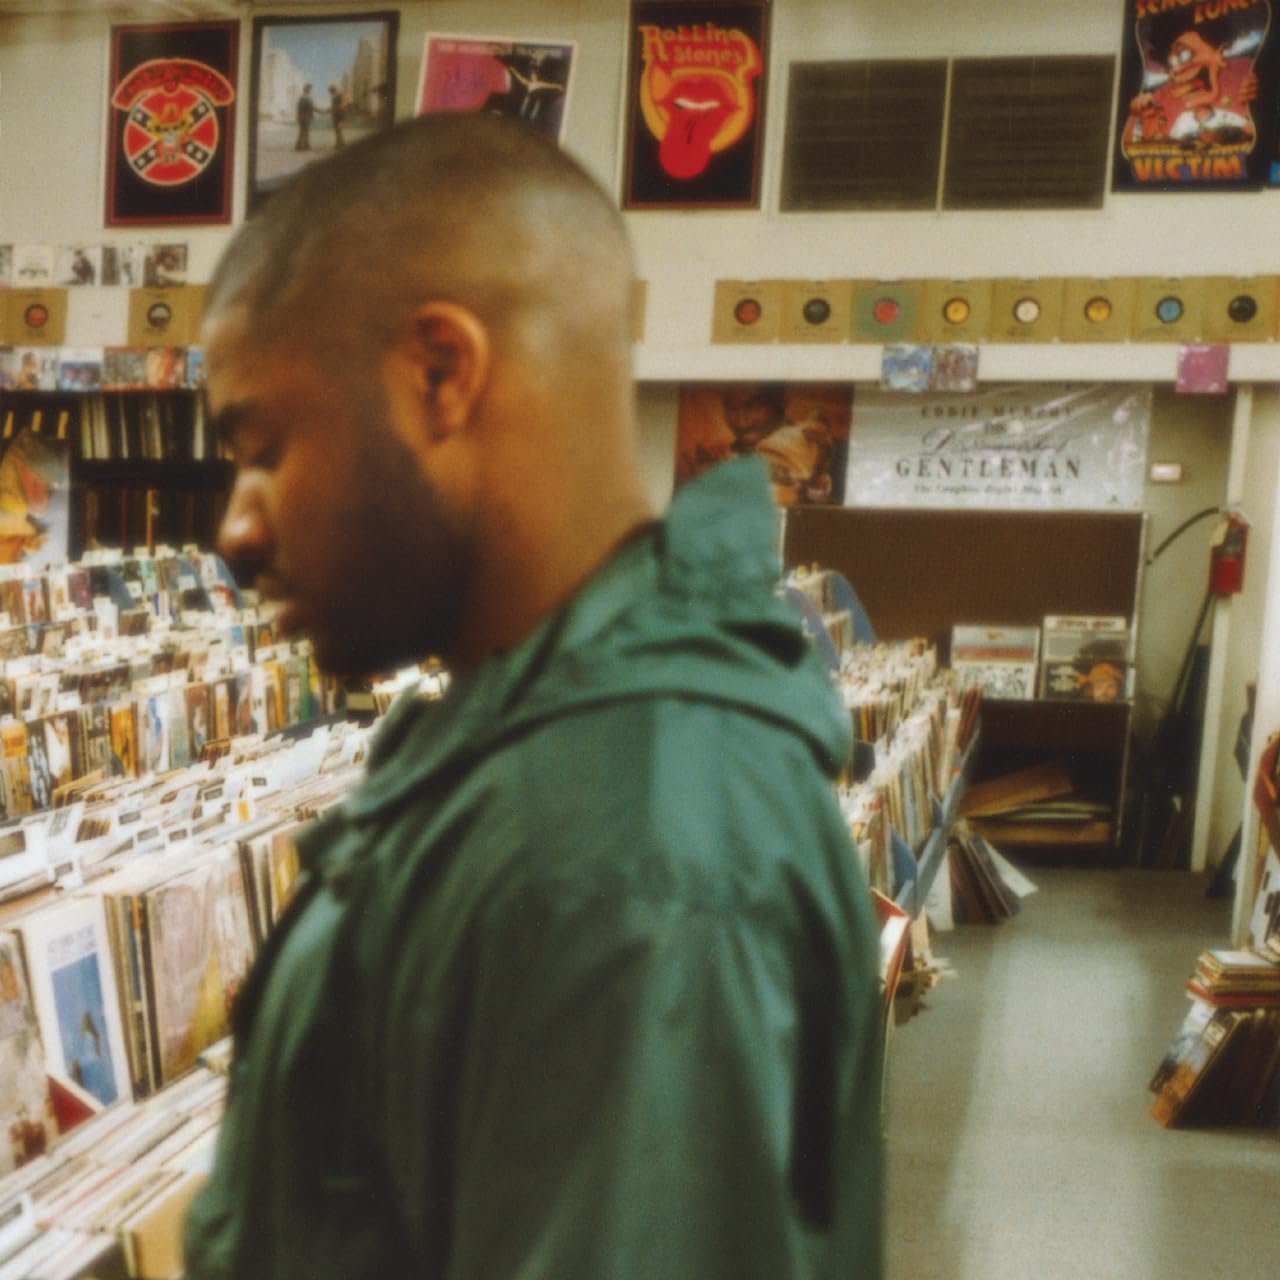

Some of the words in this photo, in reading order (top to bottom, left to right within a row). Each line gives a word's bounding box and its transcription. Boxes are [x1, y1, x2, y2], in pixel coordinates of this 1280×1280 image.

[1134, 155, 1243, 181] VICTIM
[920, 405, 980, 418] EDDIE
[894, 457, 1082, 479] GENTLEMAN
